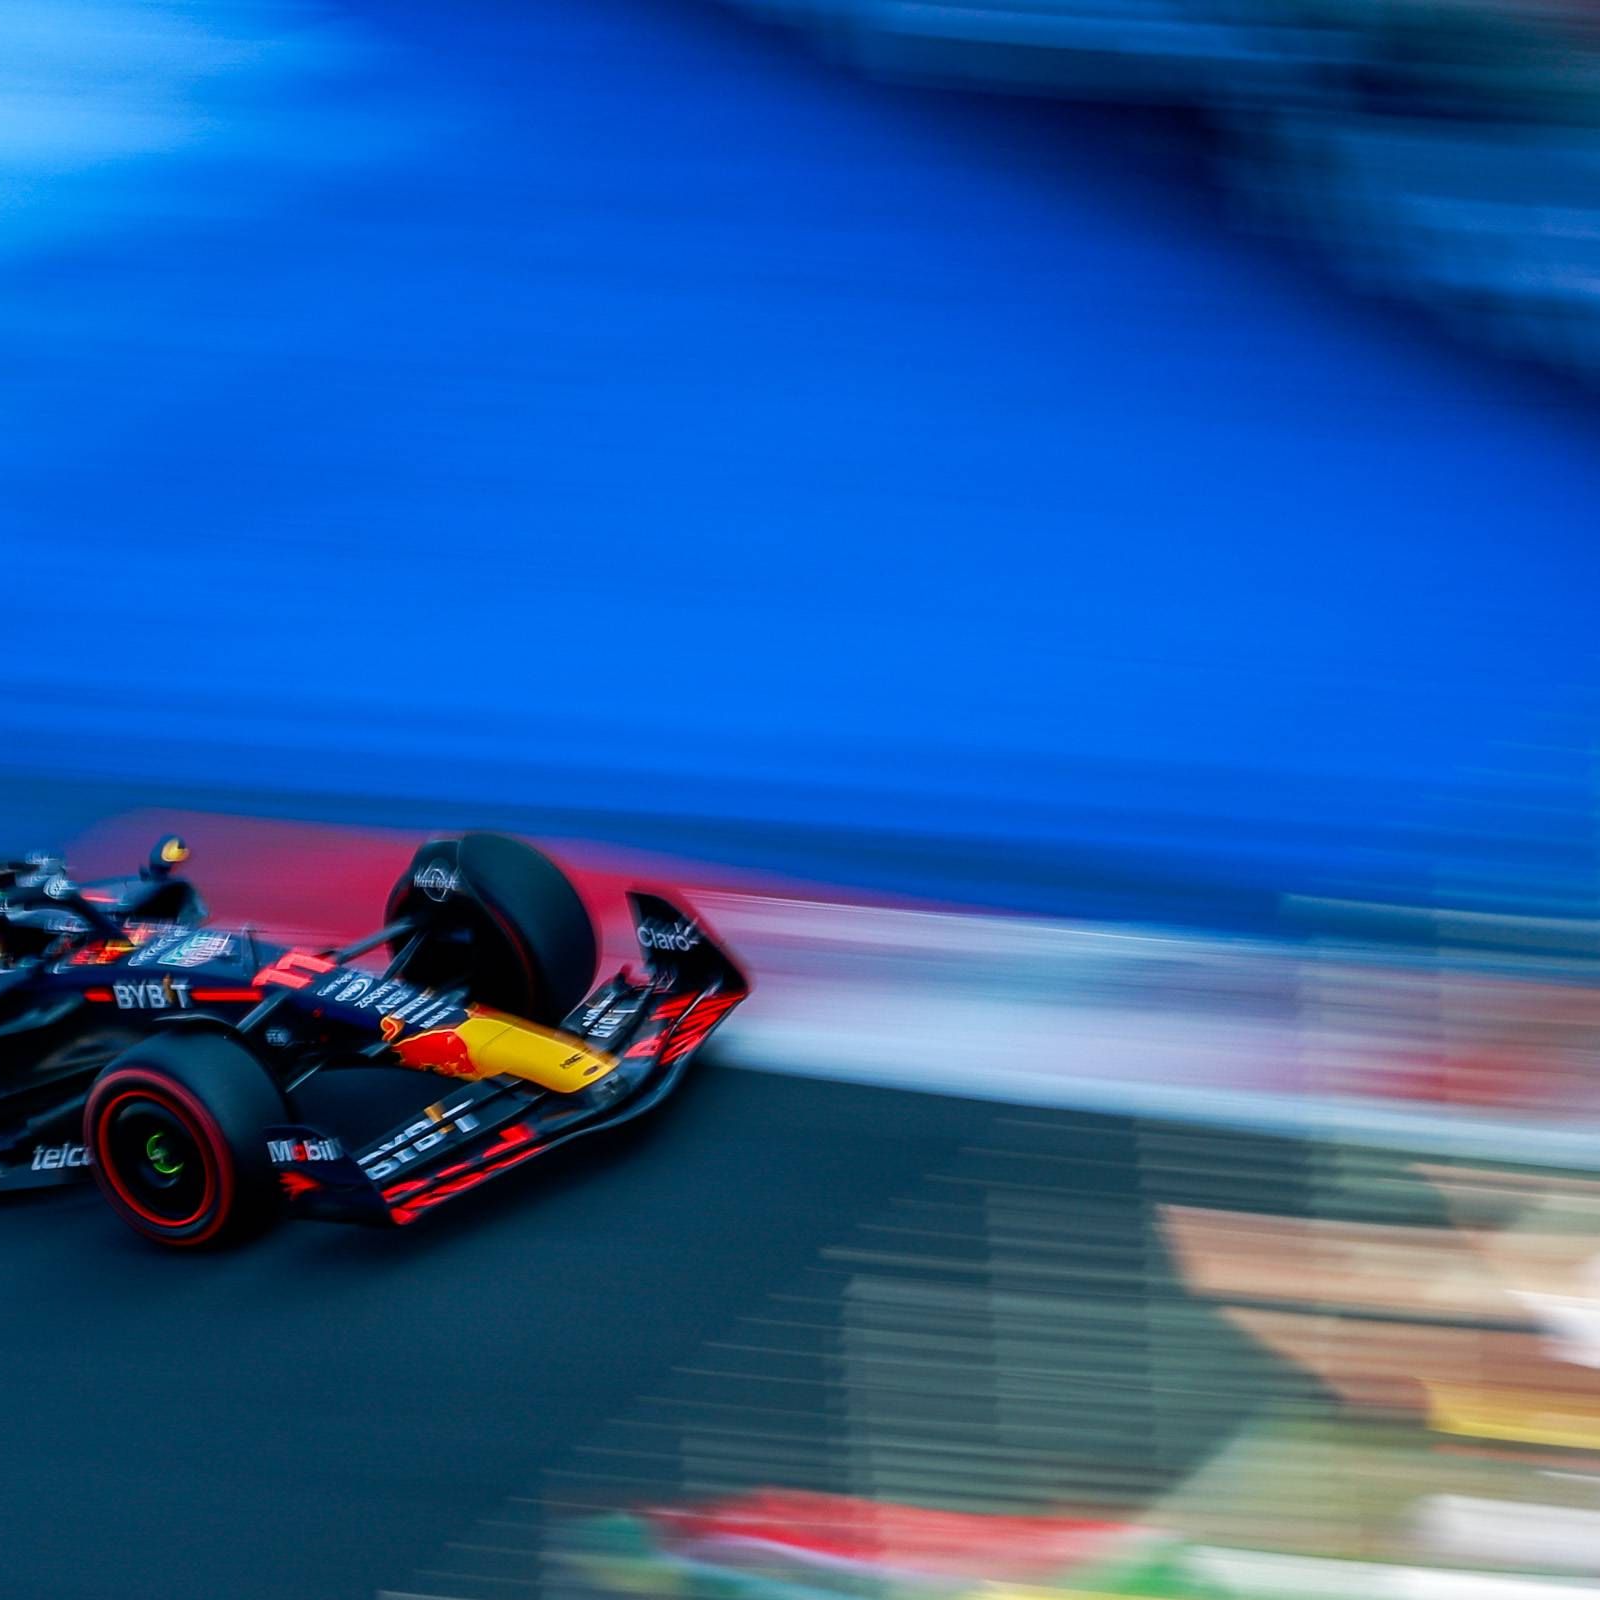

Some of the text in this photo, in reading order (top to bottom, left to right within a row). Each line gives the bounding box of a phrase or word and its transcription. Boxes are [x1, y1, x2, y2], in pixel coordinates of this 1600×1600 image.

[637, 925, 691, 951] Claro
[252, 946, 337, 989] 11
[113, 974, 192, 1009] BYBIT
[31, 1141, 93, 1171] telc
[266, 1138, 338, 1163] Mobil
